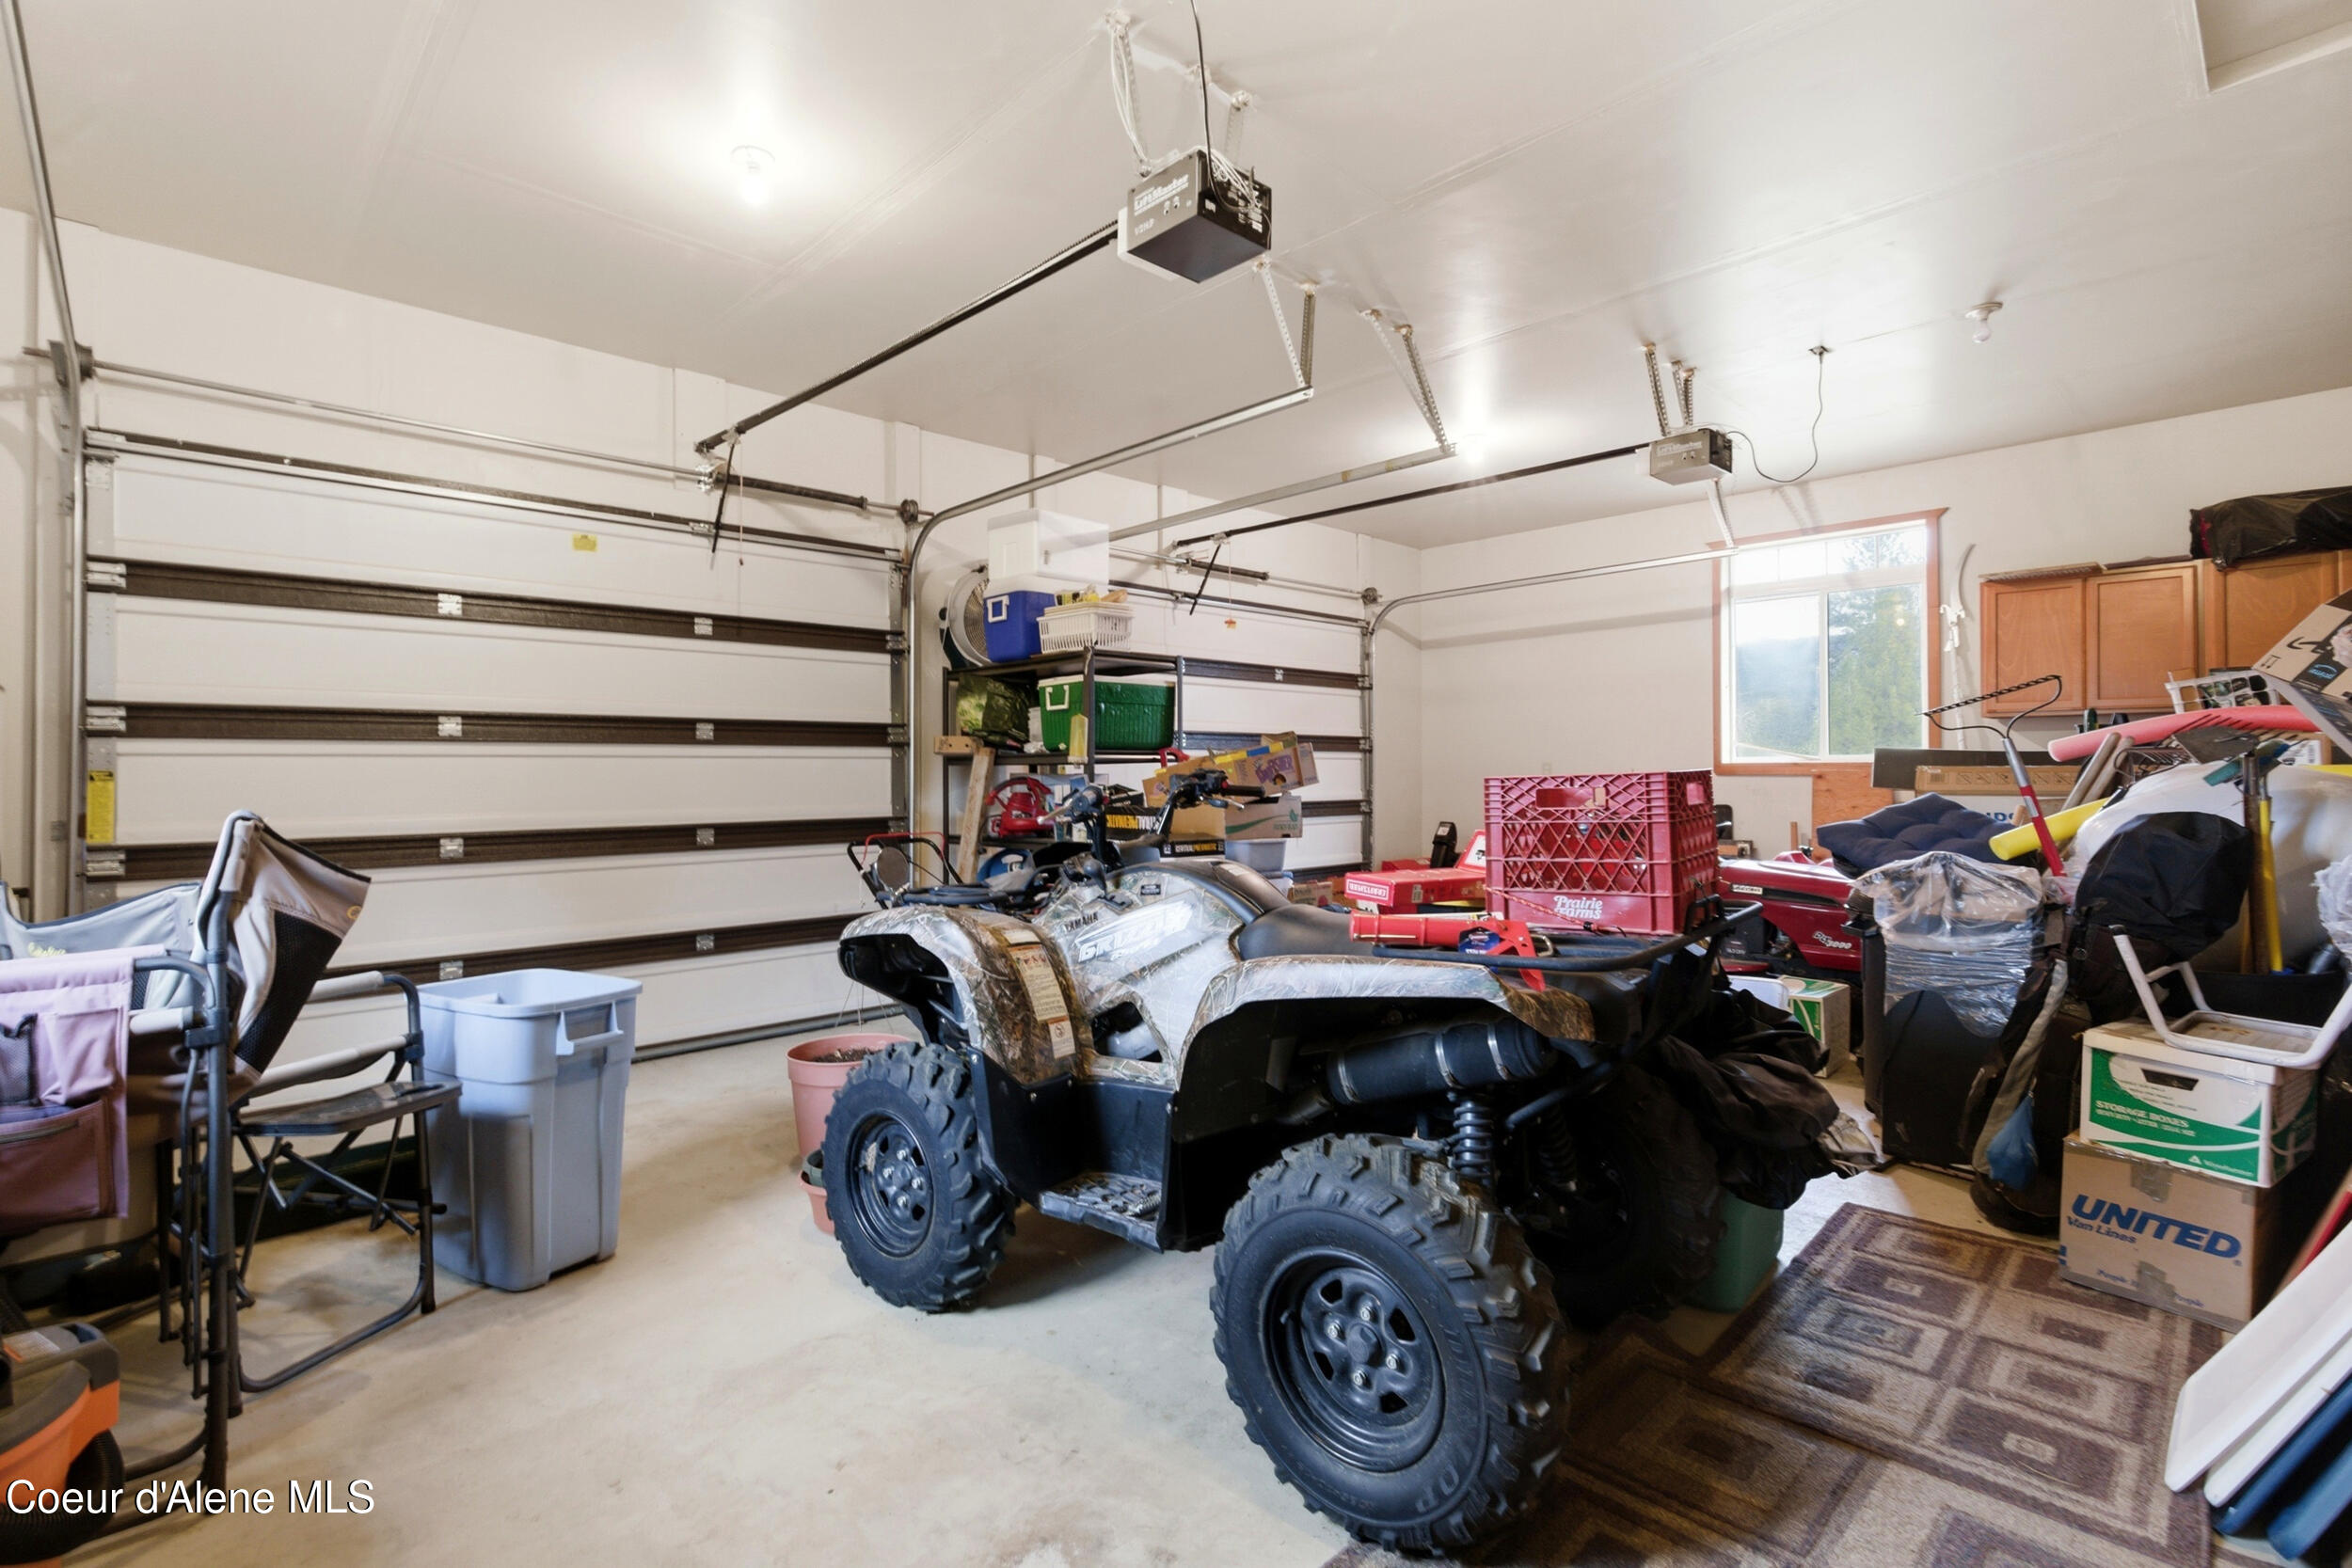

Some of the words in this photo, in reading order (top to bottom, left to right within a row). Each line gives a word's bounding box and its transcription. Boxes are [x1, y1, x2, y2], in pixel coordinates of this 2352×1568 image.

[1553, 895, 1603, 911] Prairie
[1064, 911, 1099, 933] YAMAHA
[2094, 1099, 2147, 1117] STORAGE
[2149, 1112, 2190, 1129] BOXES
[2067, 1215, 2094, 1232] Van
[2095, 1224, 2137, 1244] Lines
[2072, 1194, 2242, 1259] UNITED
